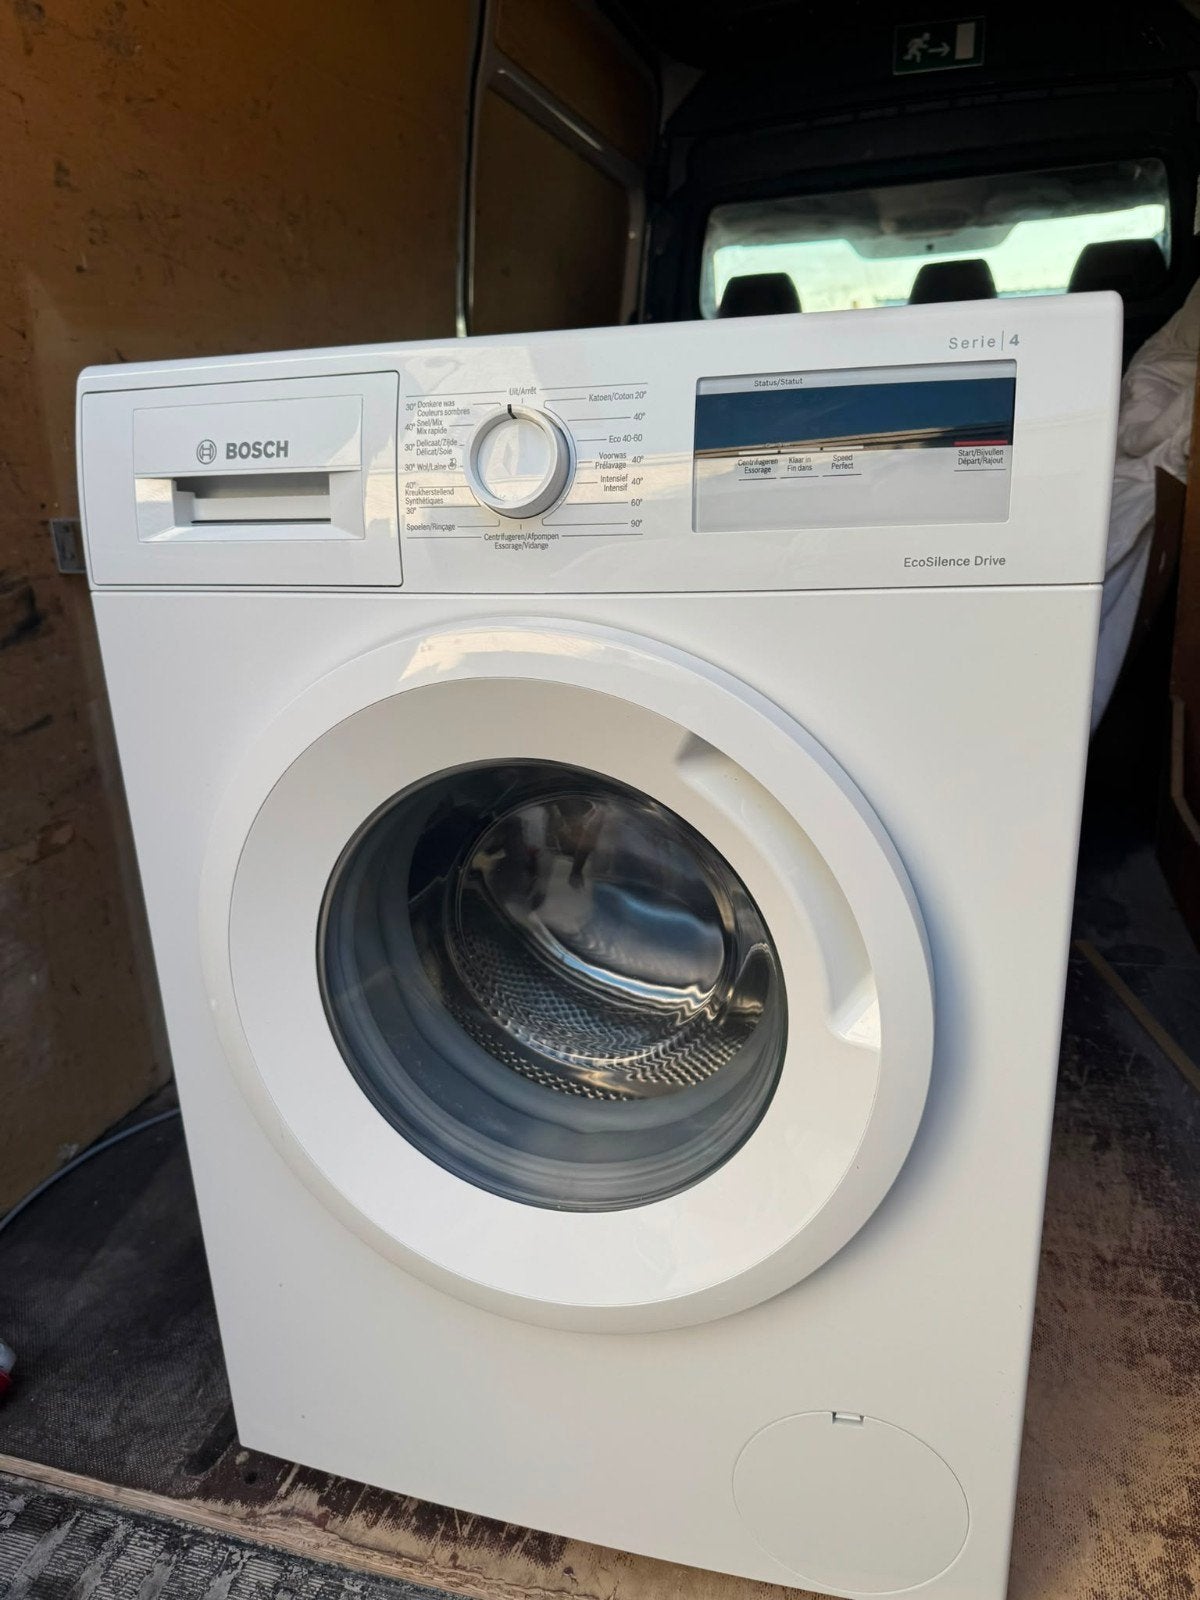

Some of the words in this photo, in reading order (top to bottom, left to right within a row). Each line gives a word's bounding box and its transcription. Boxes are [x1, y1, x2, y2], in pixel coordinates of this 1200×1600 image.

[754, 378, 803, 387] Status/Statut
[509, 387, 536, 395] Uit/Arrêt
[589, 393, 634, 402] Katoen/Coton
[417, 419, 442, 427] Snel/Mix
[428, 427, 447, 436] rapide
[416, 439, 457, 447] Delicaat/Zijde
[609, 435, 621, 443] Eco
[622, 434, 642, 442] 40-60
[226, 440, 288, 460] BOSCH
[416, 448, 452, 456] Délicat/Soie
[958, 448, 1004, 457] Start/Bijvullen
[833, 454, 853, 462] Speed
[958, 457, 1003, 466] Départ/Rajout
[417, 463, 446, 471] Wol/Laine
[595, 461, 626, 470] Prélavage
[831, 462, 853, 470] Perfect
[600, 475, 628, 483] Intensief
[405, 488, 454, 496] Kreukherstellend
[603, 483, 628, 492] Intensif
[405, 497, 443, 505] Synthétiques
[407, 522, 456, 532] Spoelen/Rinçage
[484, 532, 559, 542] Centrifugeren/Afpompen
[495, 541, 549, 550] Essorage/Vidange
[904, 556, 970, 568] EcoSilence
[974, 555, 1006, 566] Drive
